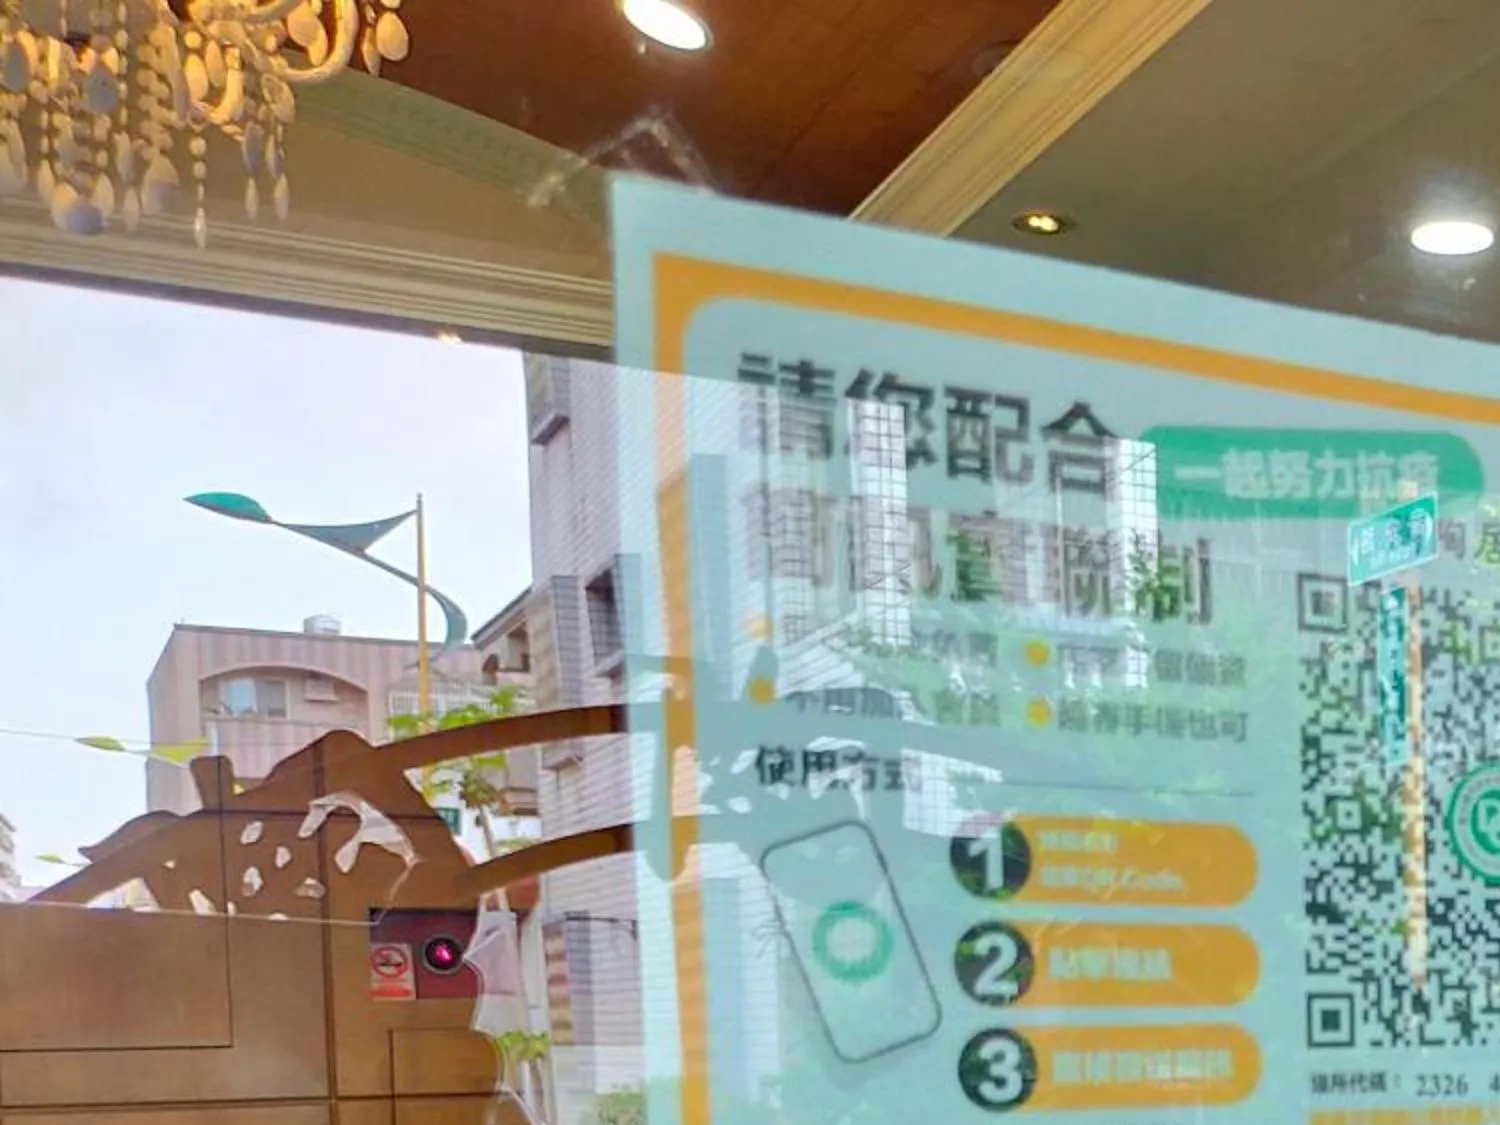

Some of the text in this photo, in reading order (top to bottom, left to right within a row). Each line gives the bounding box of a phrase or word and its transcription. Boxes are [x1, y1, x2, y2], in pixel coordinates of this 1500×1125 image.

[972, 932, 1019, 996] 2
[978, 1036, 1024, 1104] 3
[1416, 1071, 1469, 1097] 2326
